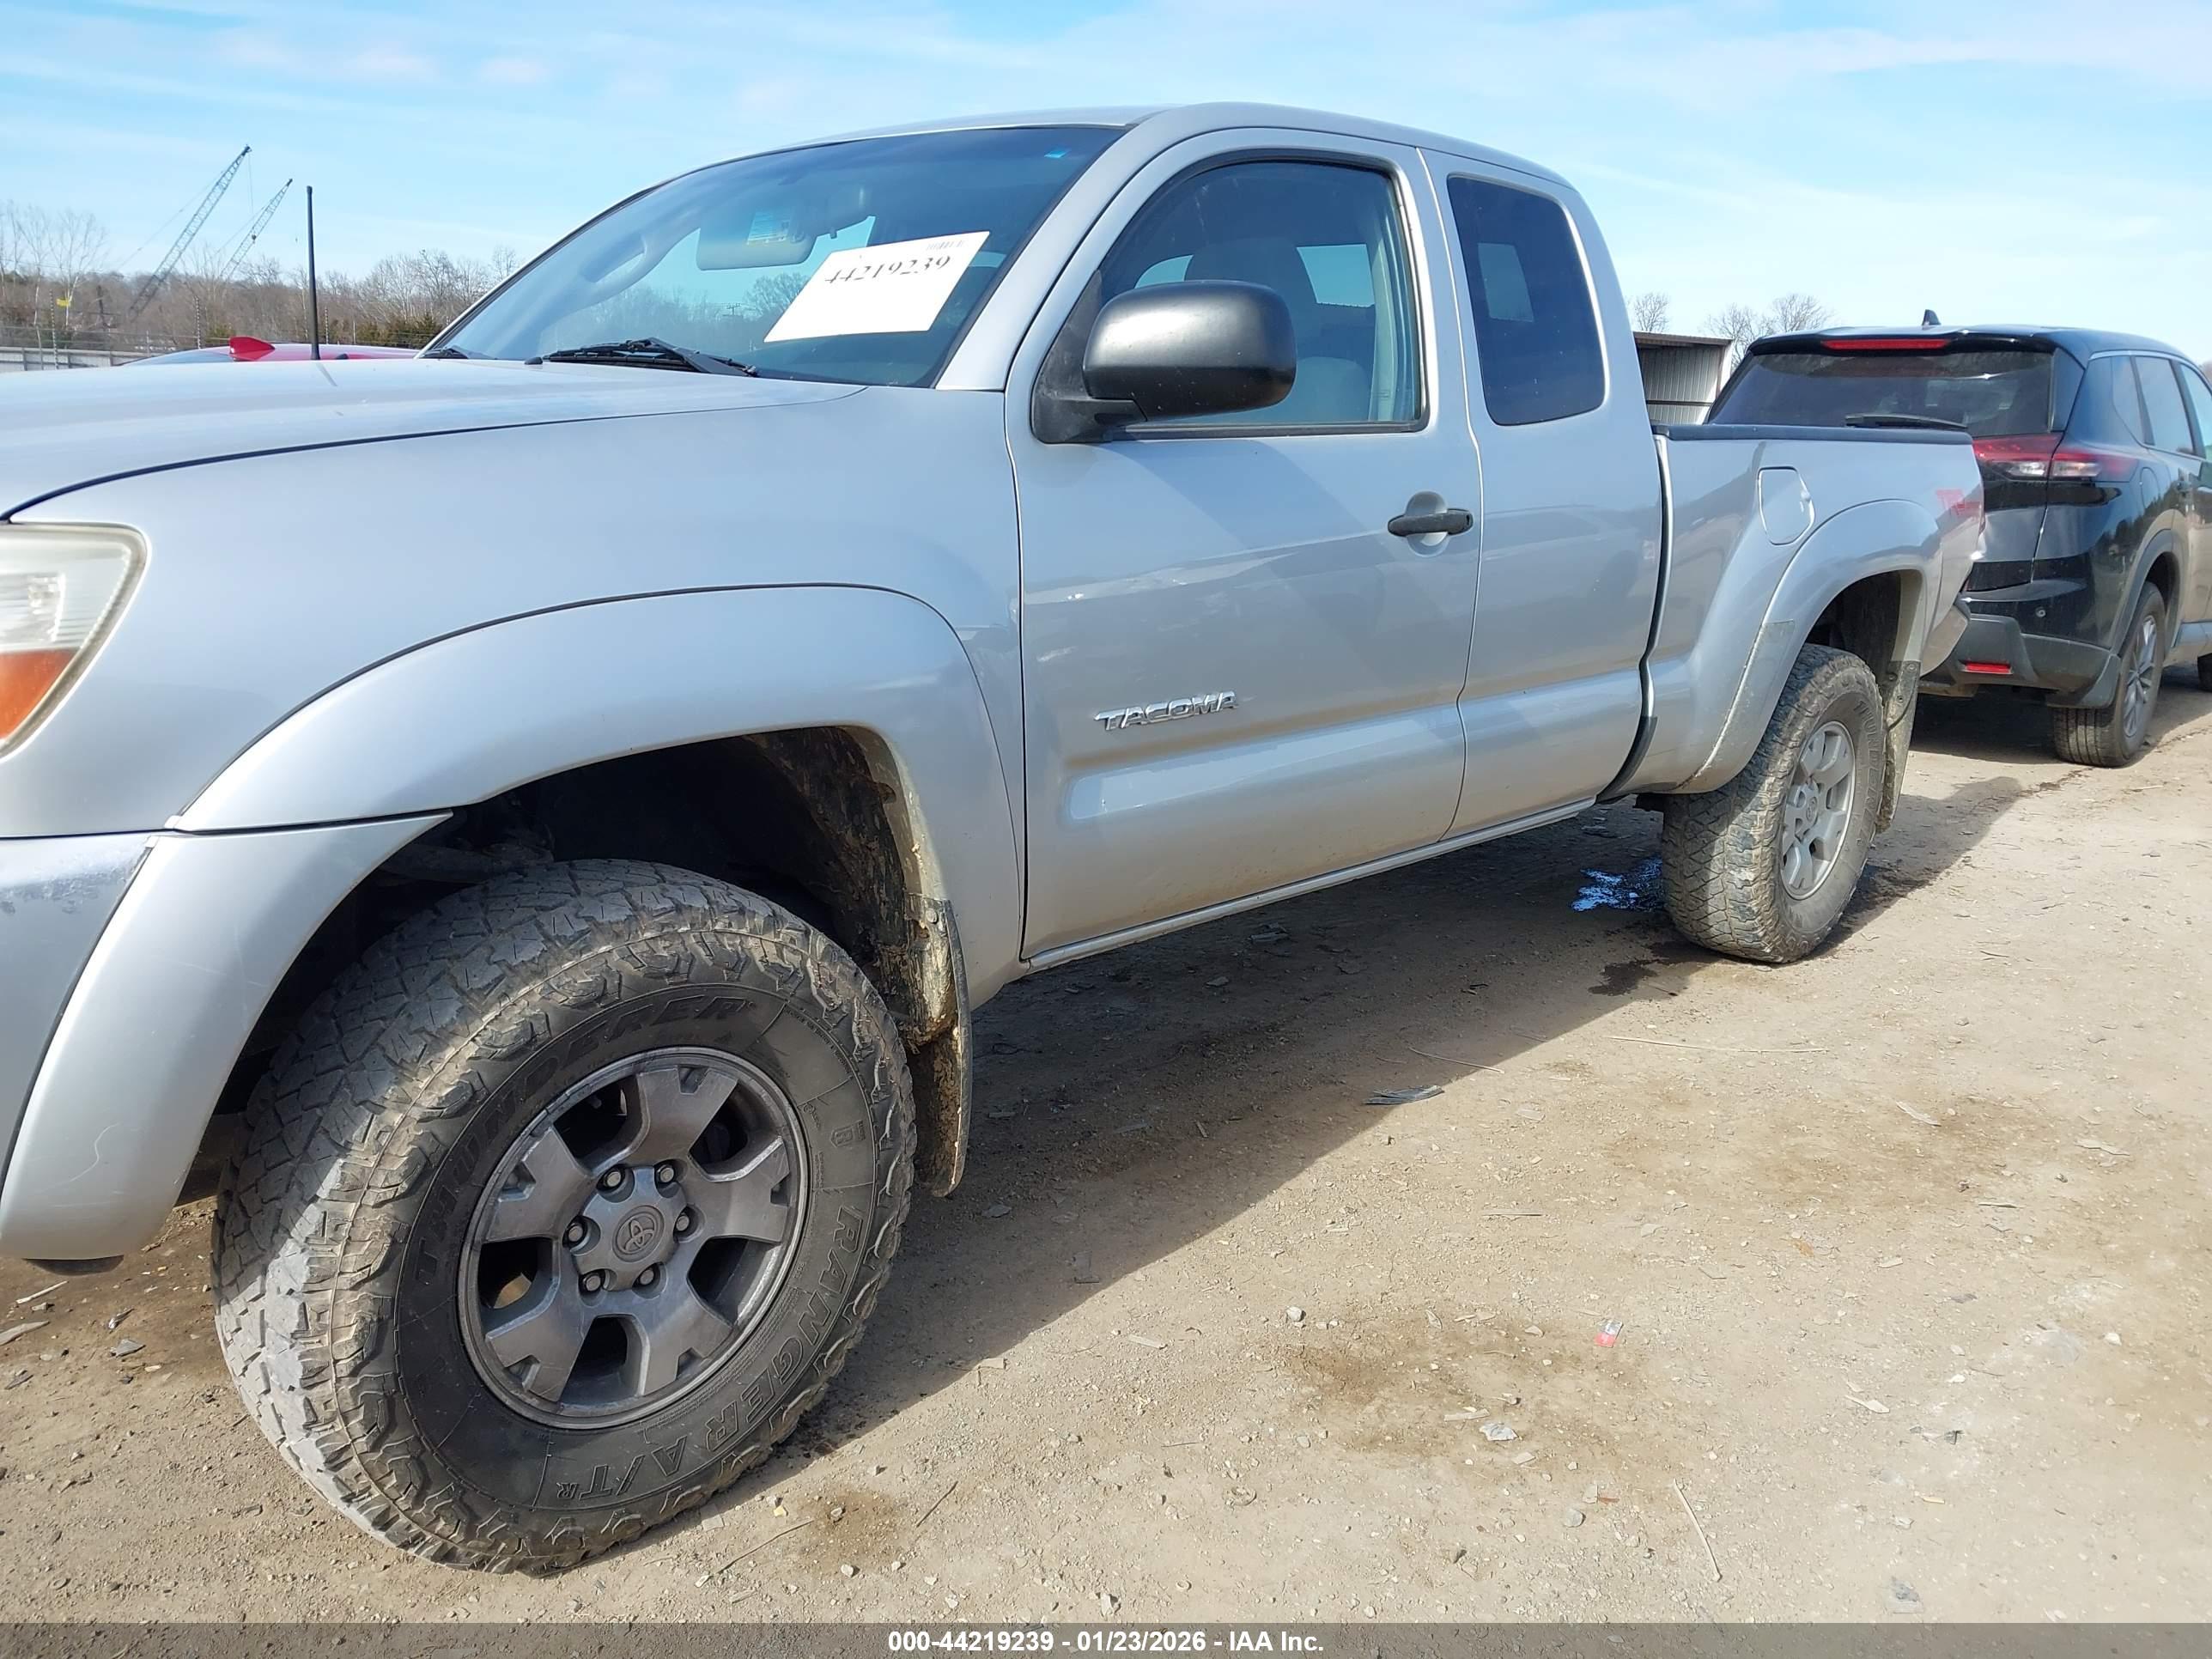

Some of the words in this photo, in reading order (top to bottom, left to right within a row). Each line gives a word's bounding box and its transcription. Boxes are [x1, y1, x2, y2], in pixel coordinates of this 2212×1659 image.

[823, 254, 951, 284] 44219239
[1094, 690, 1237, 731] TACOMA
[704, 1205, 862, 1451] RANGER
